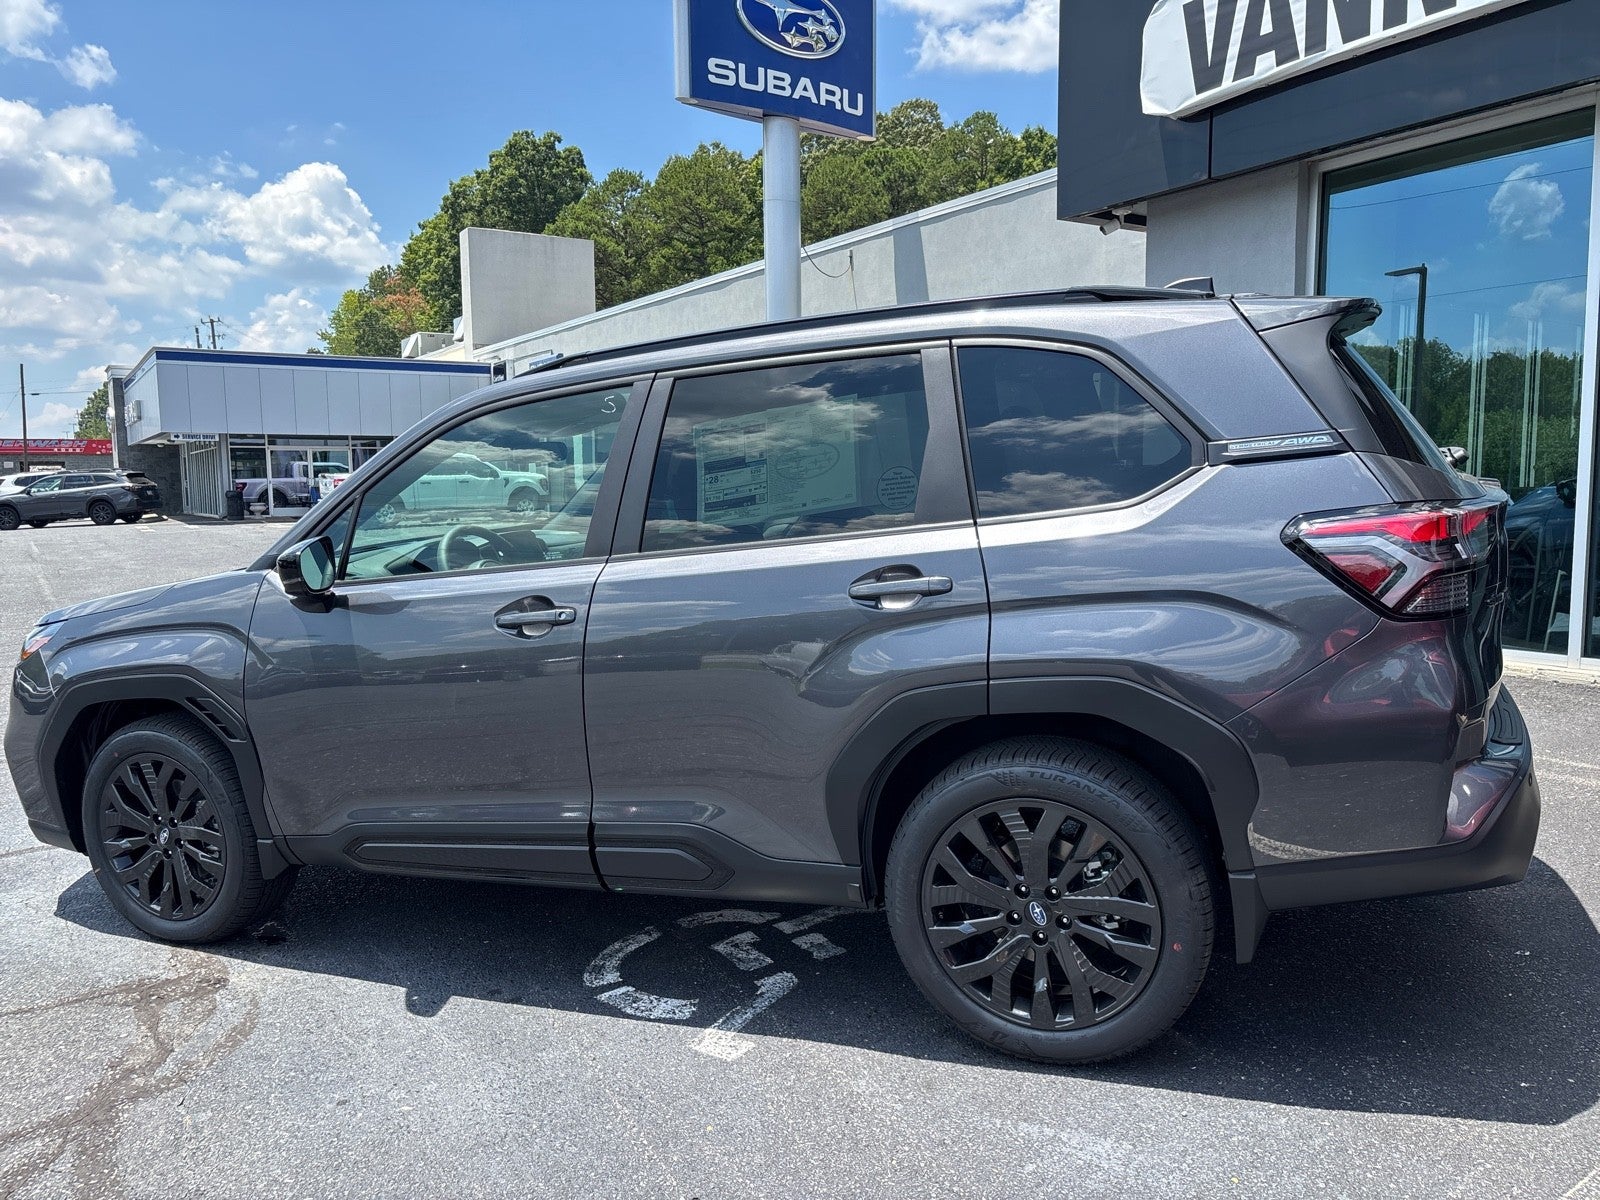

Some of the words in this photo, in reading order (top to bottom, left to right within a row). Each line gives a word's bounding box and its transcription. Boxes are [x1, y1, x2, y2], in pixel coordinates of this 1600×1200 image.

[1183, 0, 1457, 95] VAN
[707, 57, 864, 117] SUBARU
[1280, 435, 1329, 445] AWD
[1026, 770, 1120, 810] TURANZA
